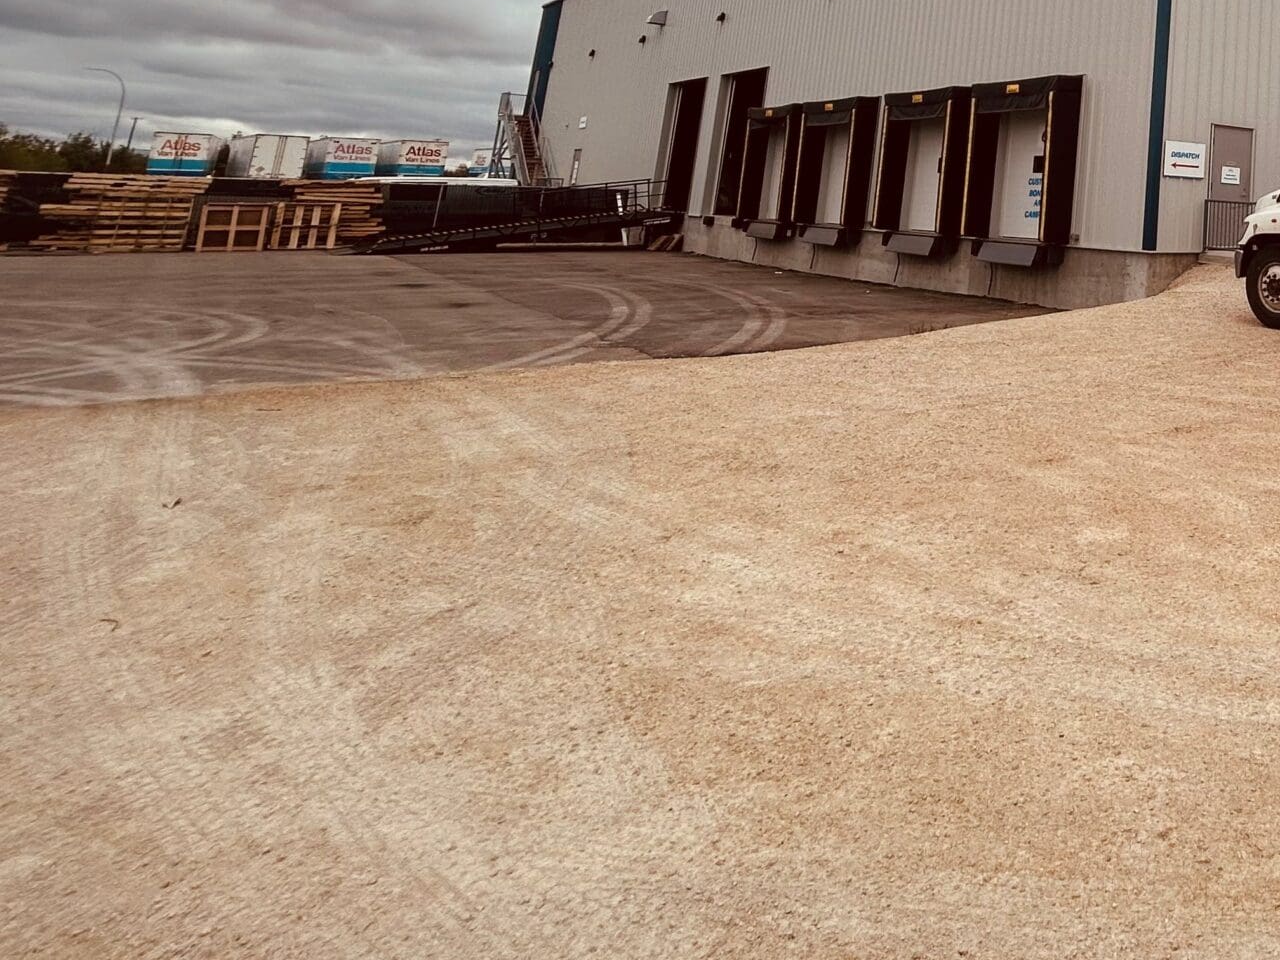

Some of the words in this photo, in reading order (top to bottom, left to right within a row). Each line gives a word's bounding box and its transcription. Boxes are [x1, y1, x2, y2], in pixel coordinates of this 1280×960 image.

[161, 139, 201, 152] Atlas
[334, 143, 373, 155] Atlas
[405, 146, 442, 158] Atlas
[1171, 151, 1200, 160] DISPATCH
